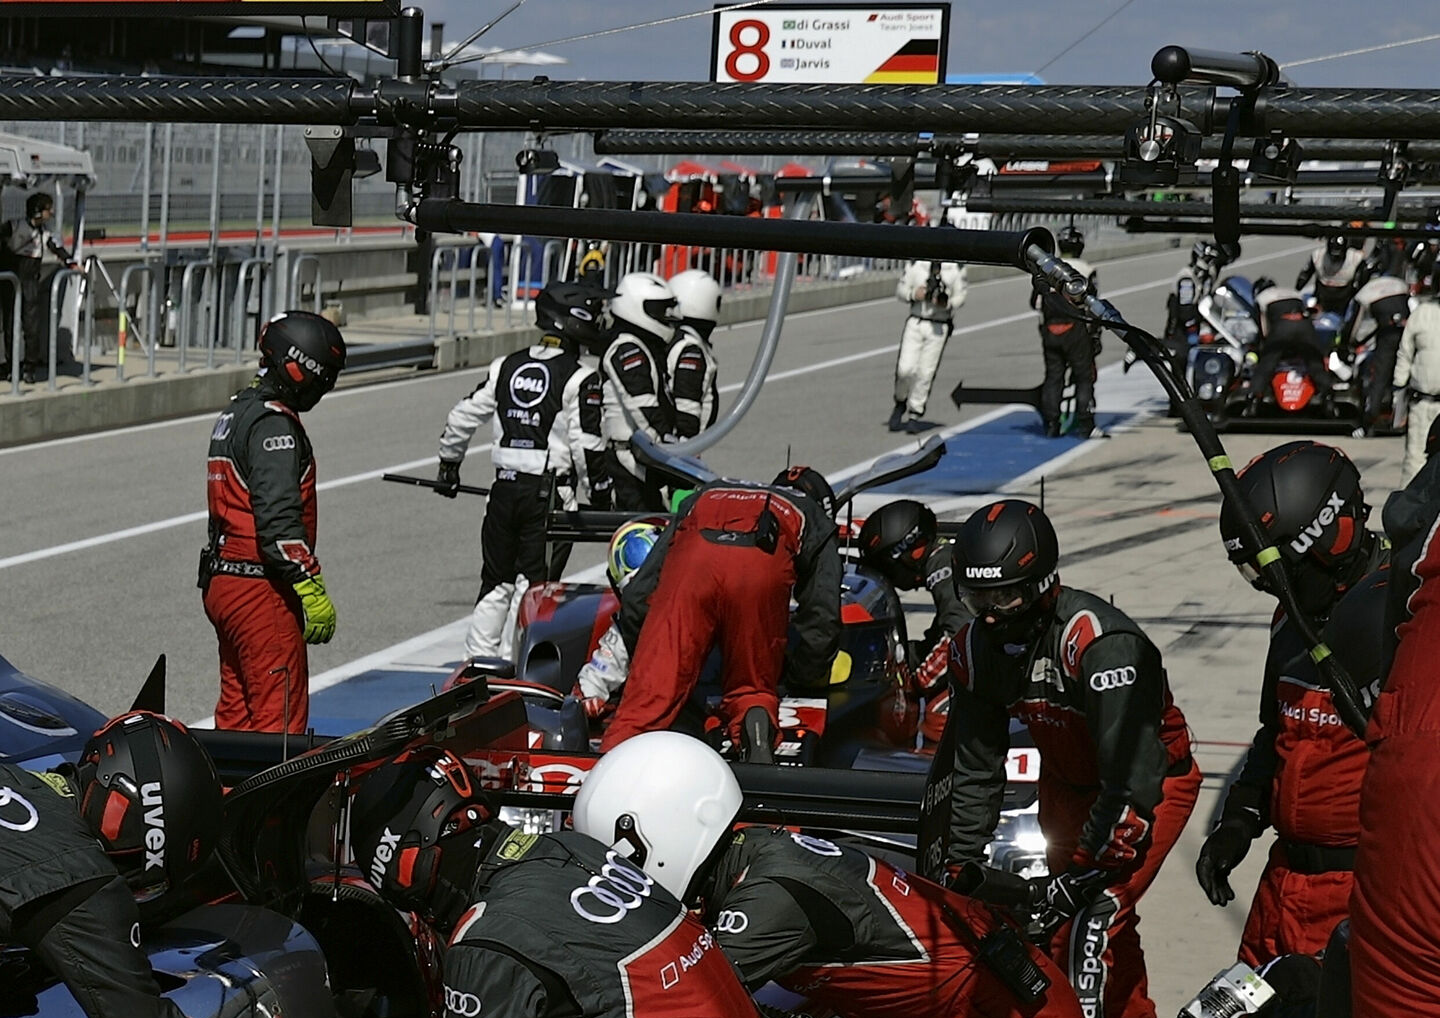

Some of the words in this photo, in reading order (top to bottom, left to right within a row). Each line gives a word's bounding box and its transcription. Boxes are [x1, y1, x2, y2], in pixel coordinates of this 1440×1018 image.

[796, 19, 809, 30] di
[812, 19, 850, 31] Grassi
[880, 13, 905, 22] Audi
[906, 13, 935, 23] Sport
[724, 19, 770, 82] 8
[796, 38, 831, 49] Duval
[795, 57, 830, 70] Jarvis
[288, 346, 324, 375] uvex
[1290, 491, 1345, 554] uvex
[966, 566, 1002, 578] uvex
[140, 782, 166, 871] uvex
[370, 827, 403, 889] uvex
[679, 946, 703, 972] Audi
[1078, 917, 1102, 990] Sport
